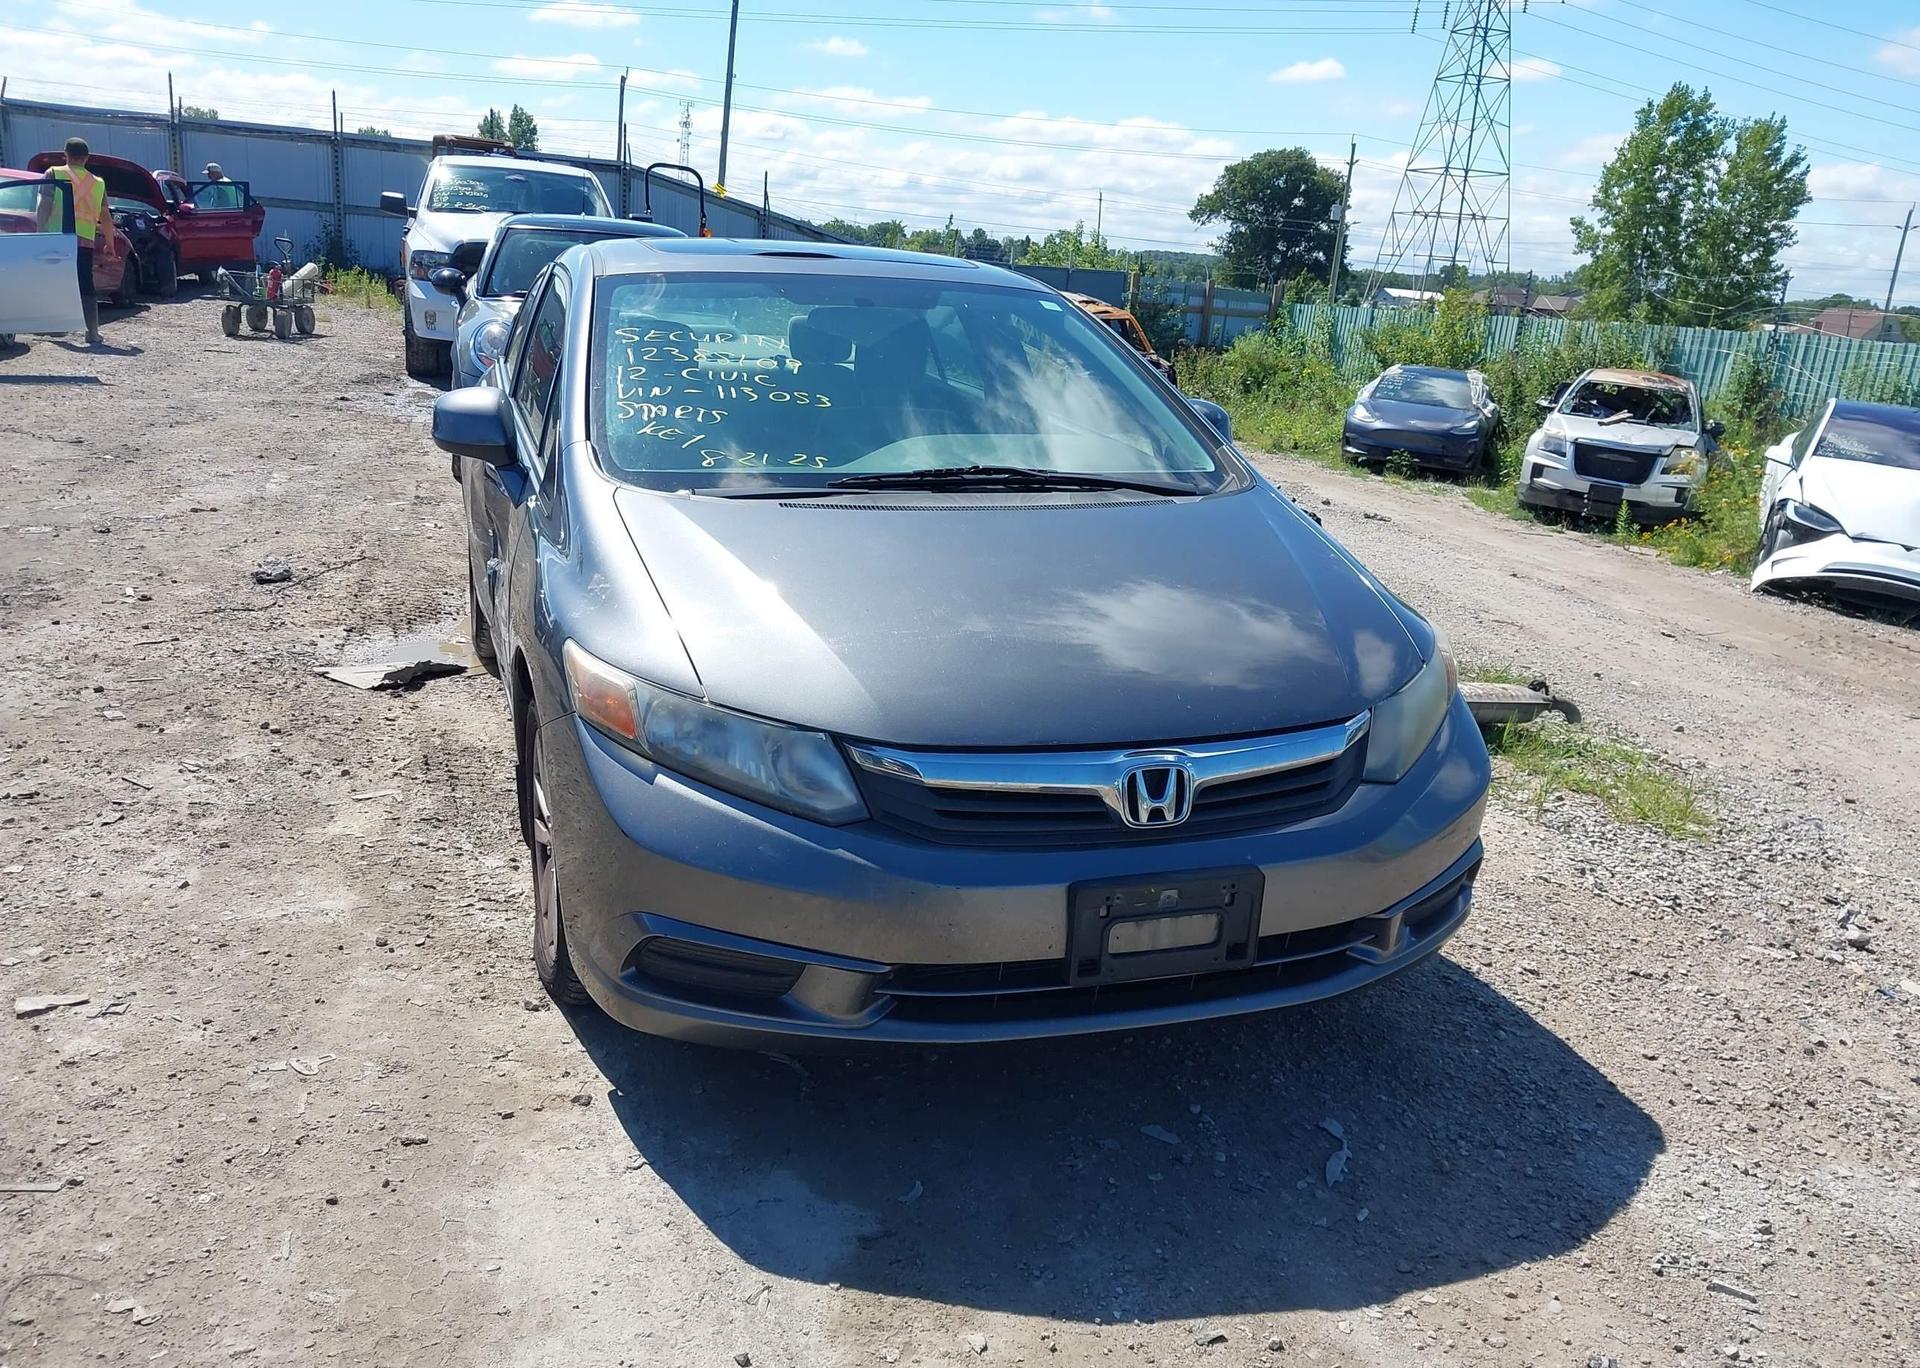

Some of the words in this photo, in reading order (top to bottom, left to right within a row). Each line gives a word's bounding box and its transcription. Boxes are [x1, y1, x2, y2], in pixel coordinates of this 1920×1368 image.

[615, 327, 786, 350] SECURITY
[616, 401, 729, 425] STARTS
[636, 421, 706, 449] KEY
